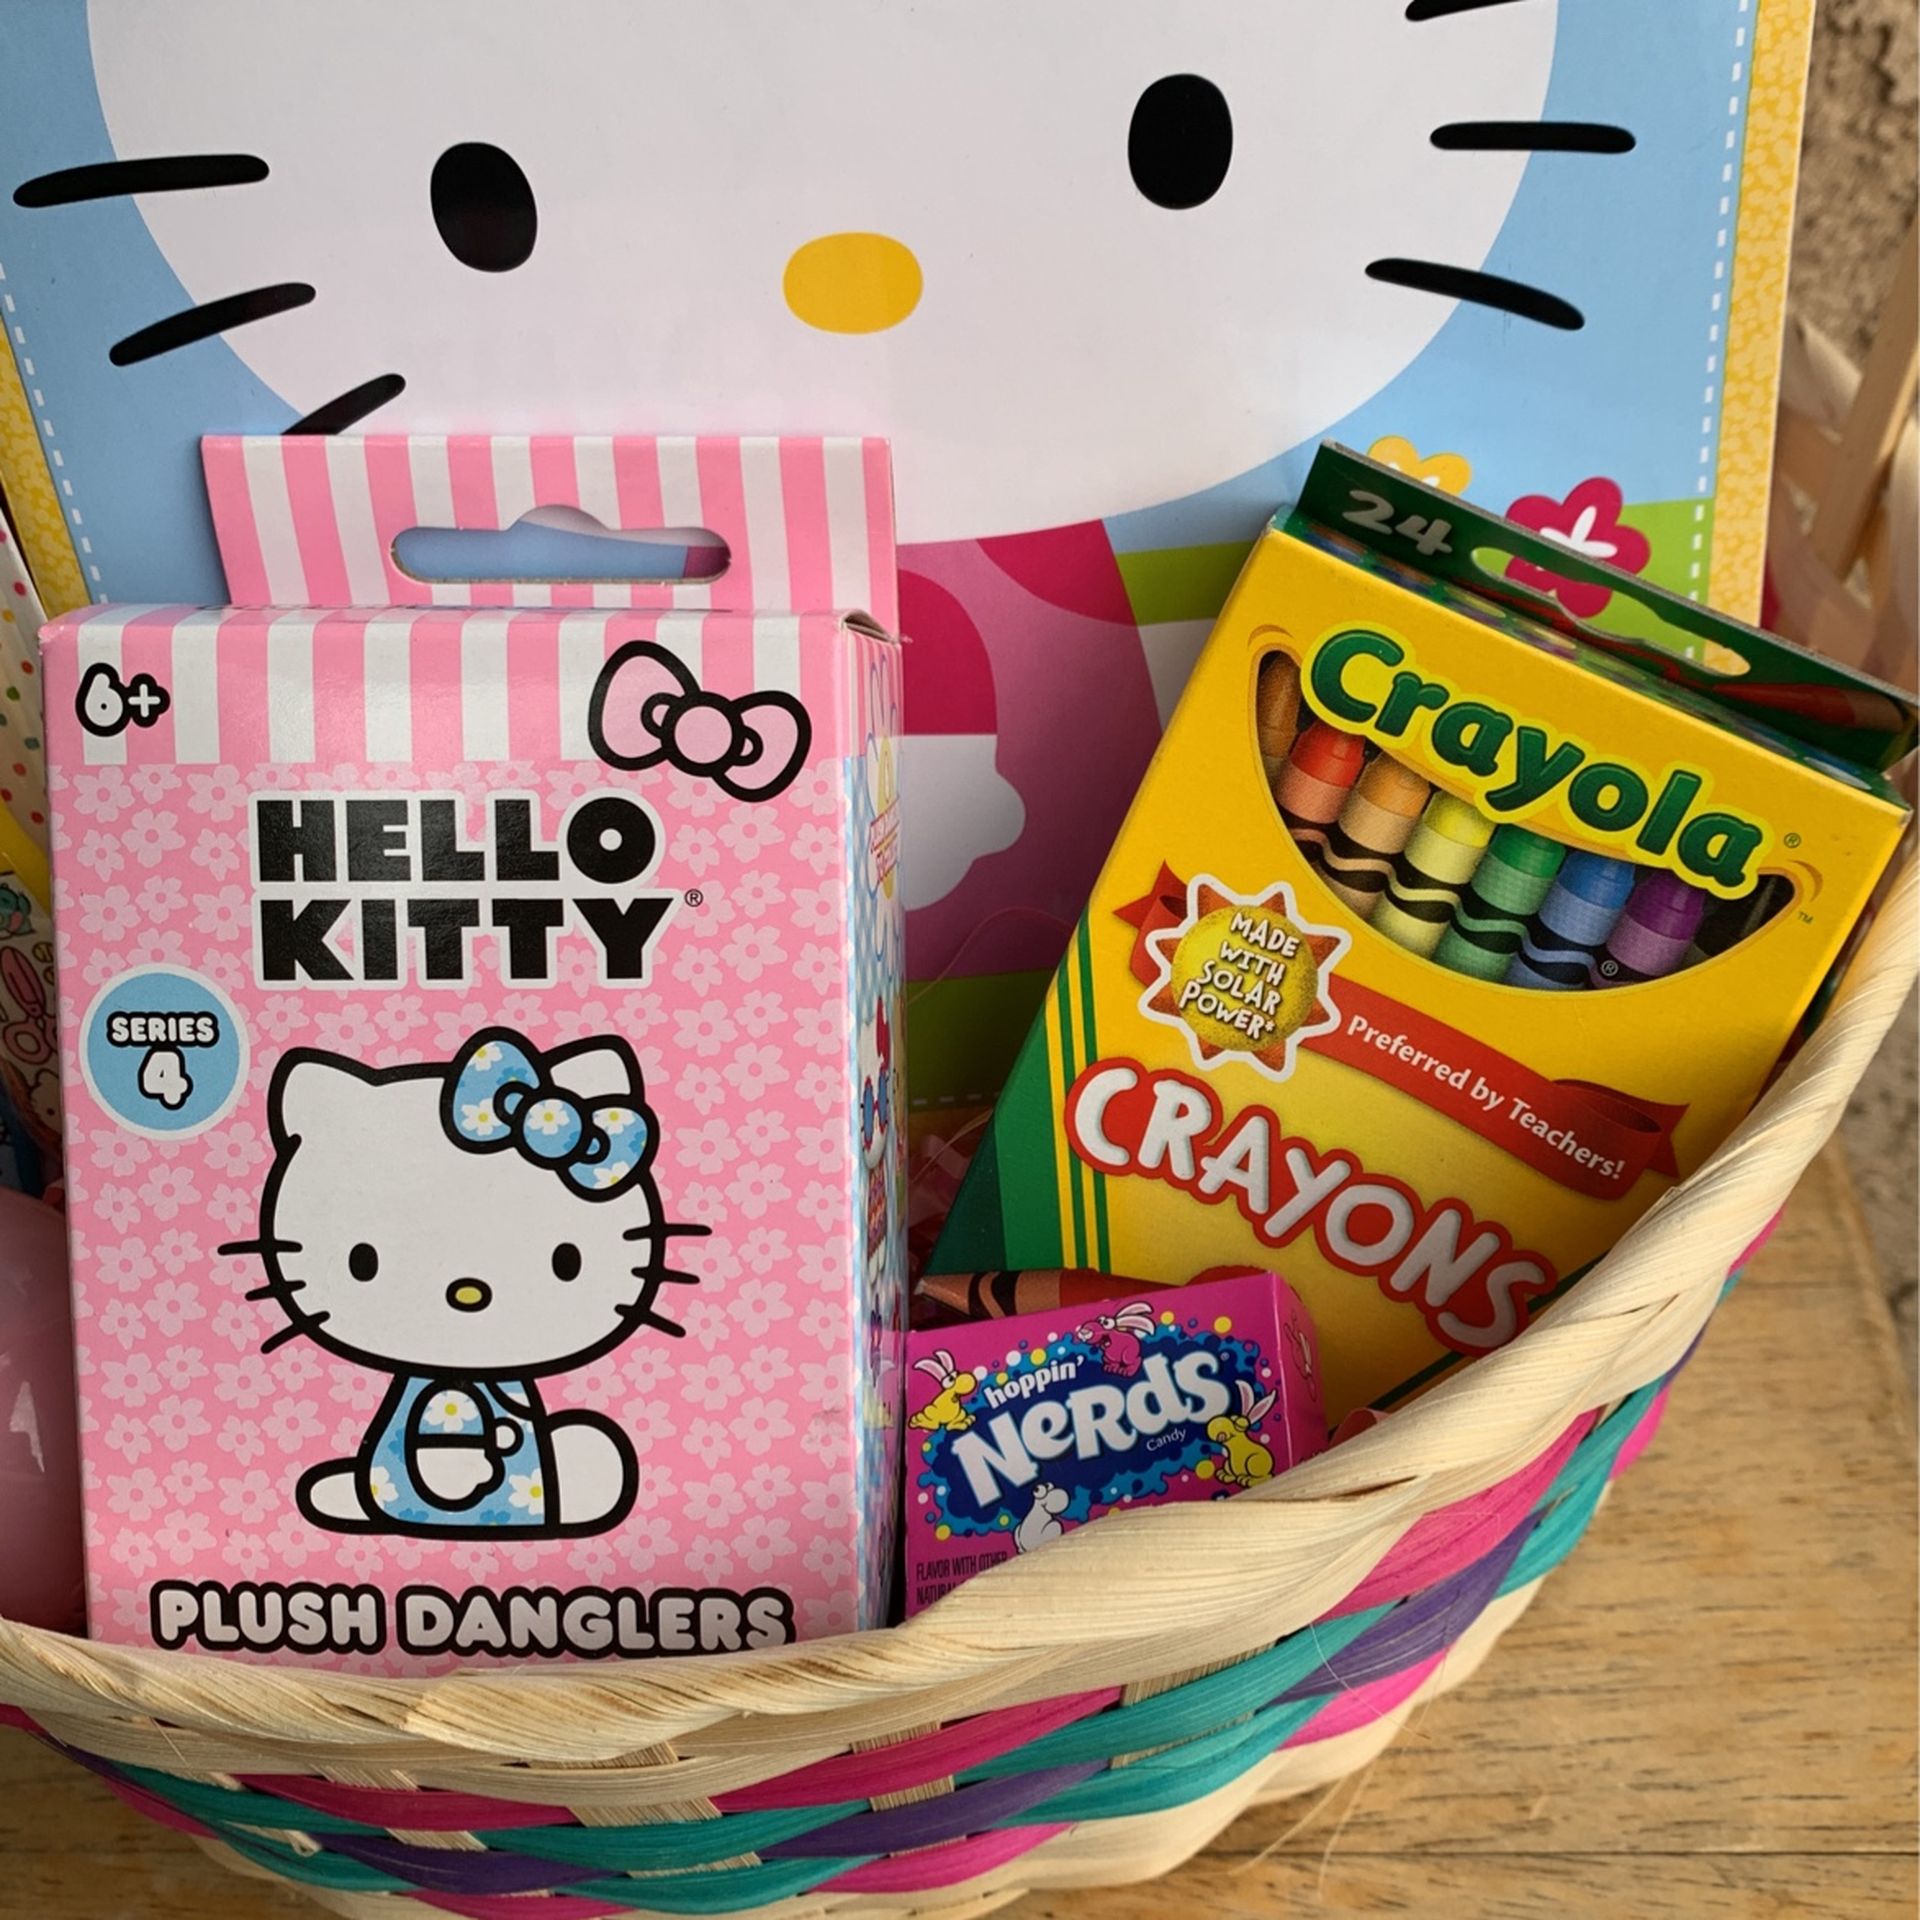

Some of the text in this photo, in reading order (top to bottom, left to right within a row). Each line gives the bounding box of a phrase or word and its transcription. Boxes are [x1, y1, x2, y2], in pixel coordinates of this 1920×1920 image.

[1342, 490, 1453, 555] 24
[81, 668, 166, 732] 6+
[1311, 629, 1763, 888] Crayola
[257, 796, 657, 884] HELLO
[260, 898, 674, 981] KITTY
[1219, 941, 1286, 986] WITH
[1230, 912, 1300, 957] MADE
[1196, 959, 1282, 1015] SOLAR
[110, 1015, 217, 1044] SERIES
[141, 1051, 191, 1107] 4
[1346, 1014, 1627, 1180] Preferred by Teachers!
[1073, 1065, 1547, 1350] CRAYONS
[1146, 1426, 1187, 1452] Candy
[916, 1558, 951, 1582] FLAVOR
[952, 1555, 978, 1577] WITH
[916, 1582, 957, 1606] NATURA
[155, 1586, 792, 1654] PLUSH DANGLERS
